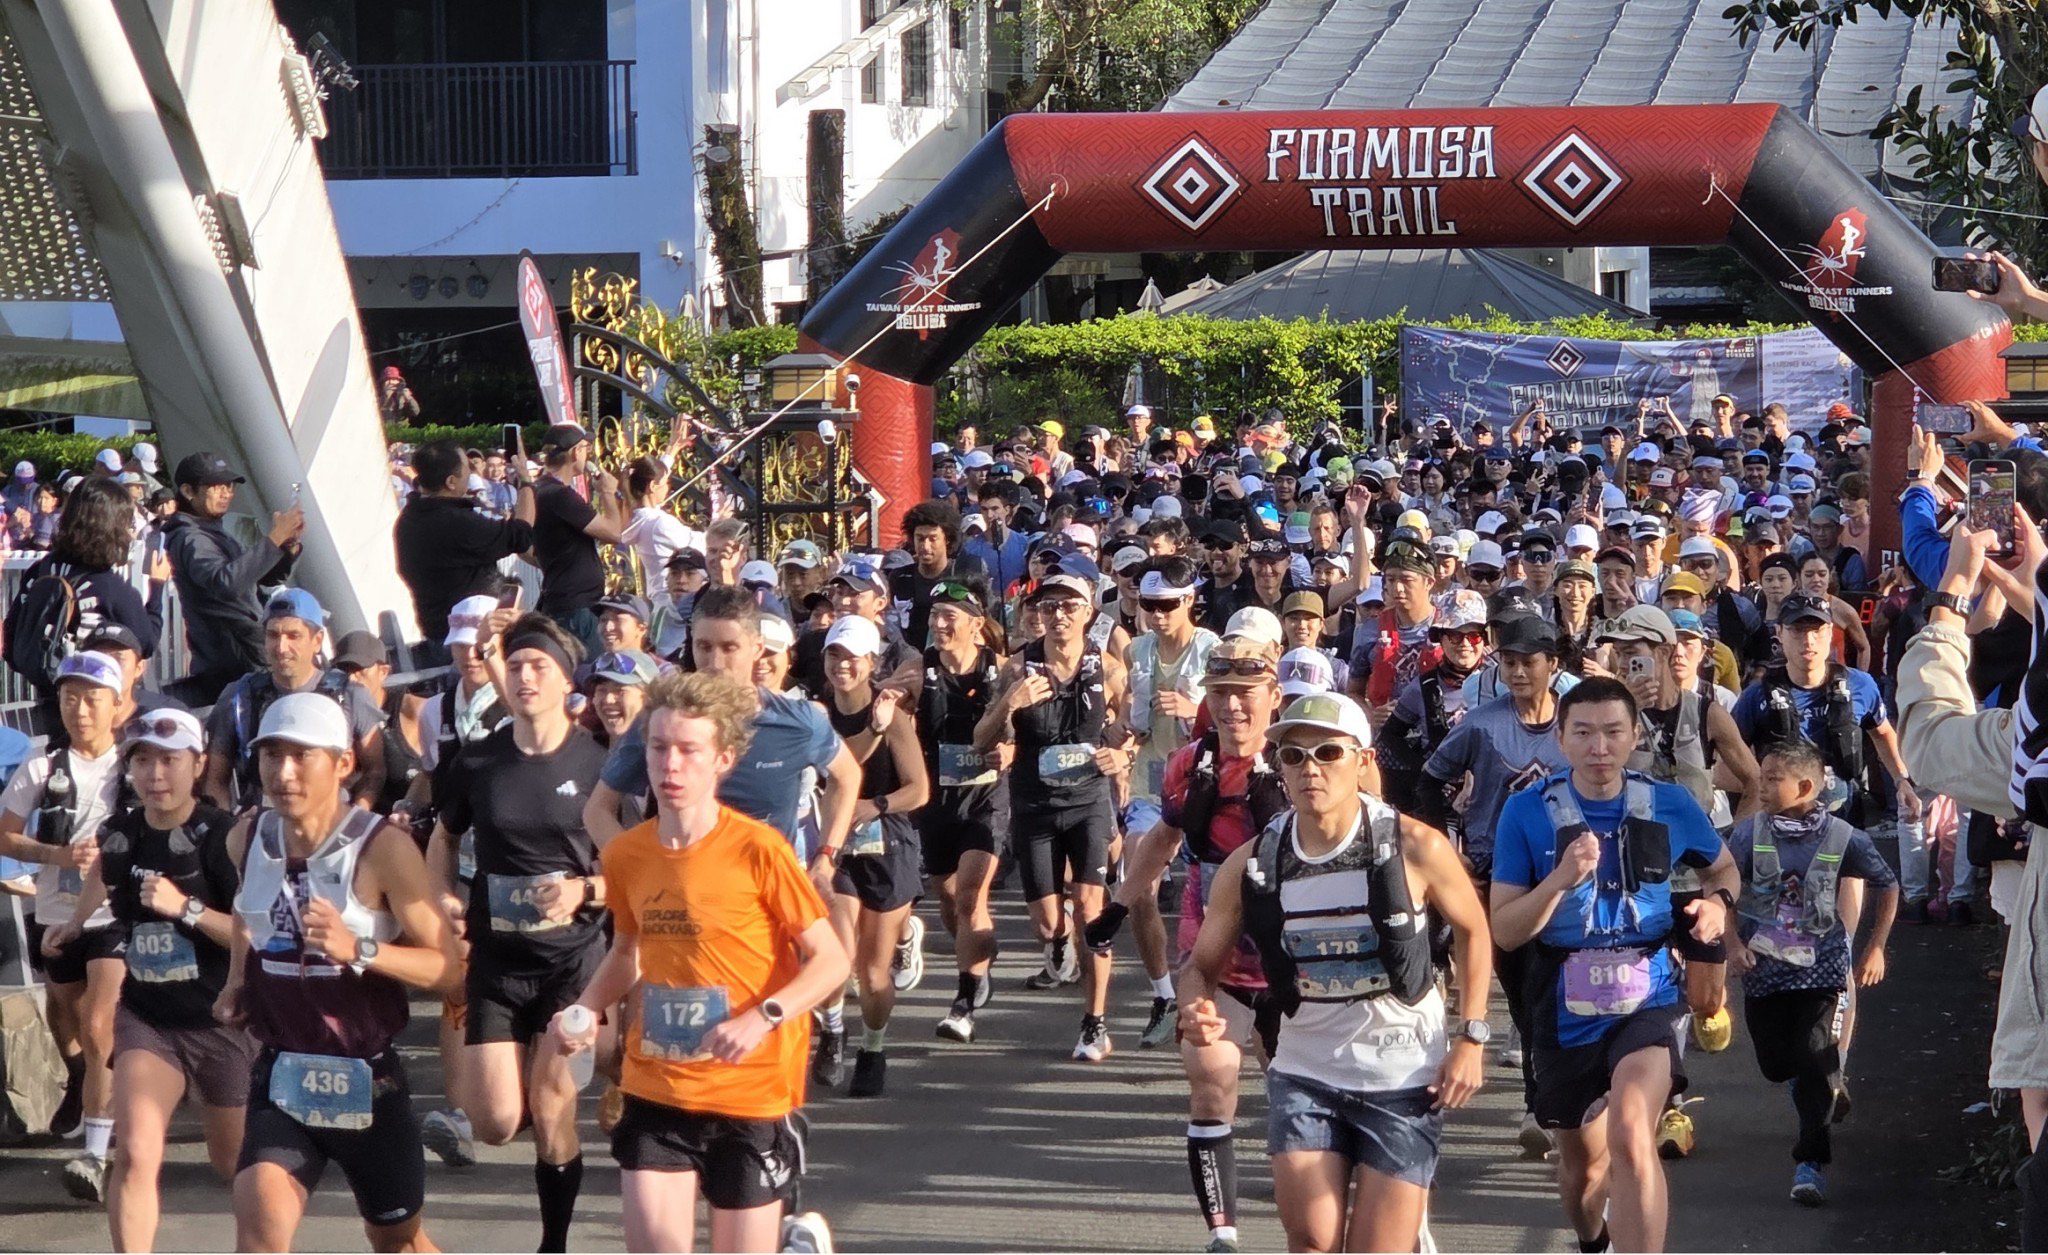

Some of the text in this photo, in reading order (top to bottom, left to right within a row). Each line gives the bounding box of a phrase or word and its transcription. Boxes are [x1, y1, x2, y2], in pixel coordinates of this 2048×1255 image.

[1266, 126, 1497, 182] FORMOSA
[1310, 186, 1457, 236] TRAIL
[1780, 281, 1893, 296] TAIWAN BEAST RUNNERS
[866, 302, 982, 313] TAIWAN BEAST RUNNERS
[1508, 376, 1631, 417] FORMOSA
[956, 753, 983, 767] 306
[1057, 752, 1086, 768] 329
[136, 933, 174, 956] 603
[1316, 941, 1360, 956] 178
[1589, 963, 1631, 986] 810
[661, 1002, 706, 1027] 172
[302, 1071, 349, 1095] 436
